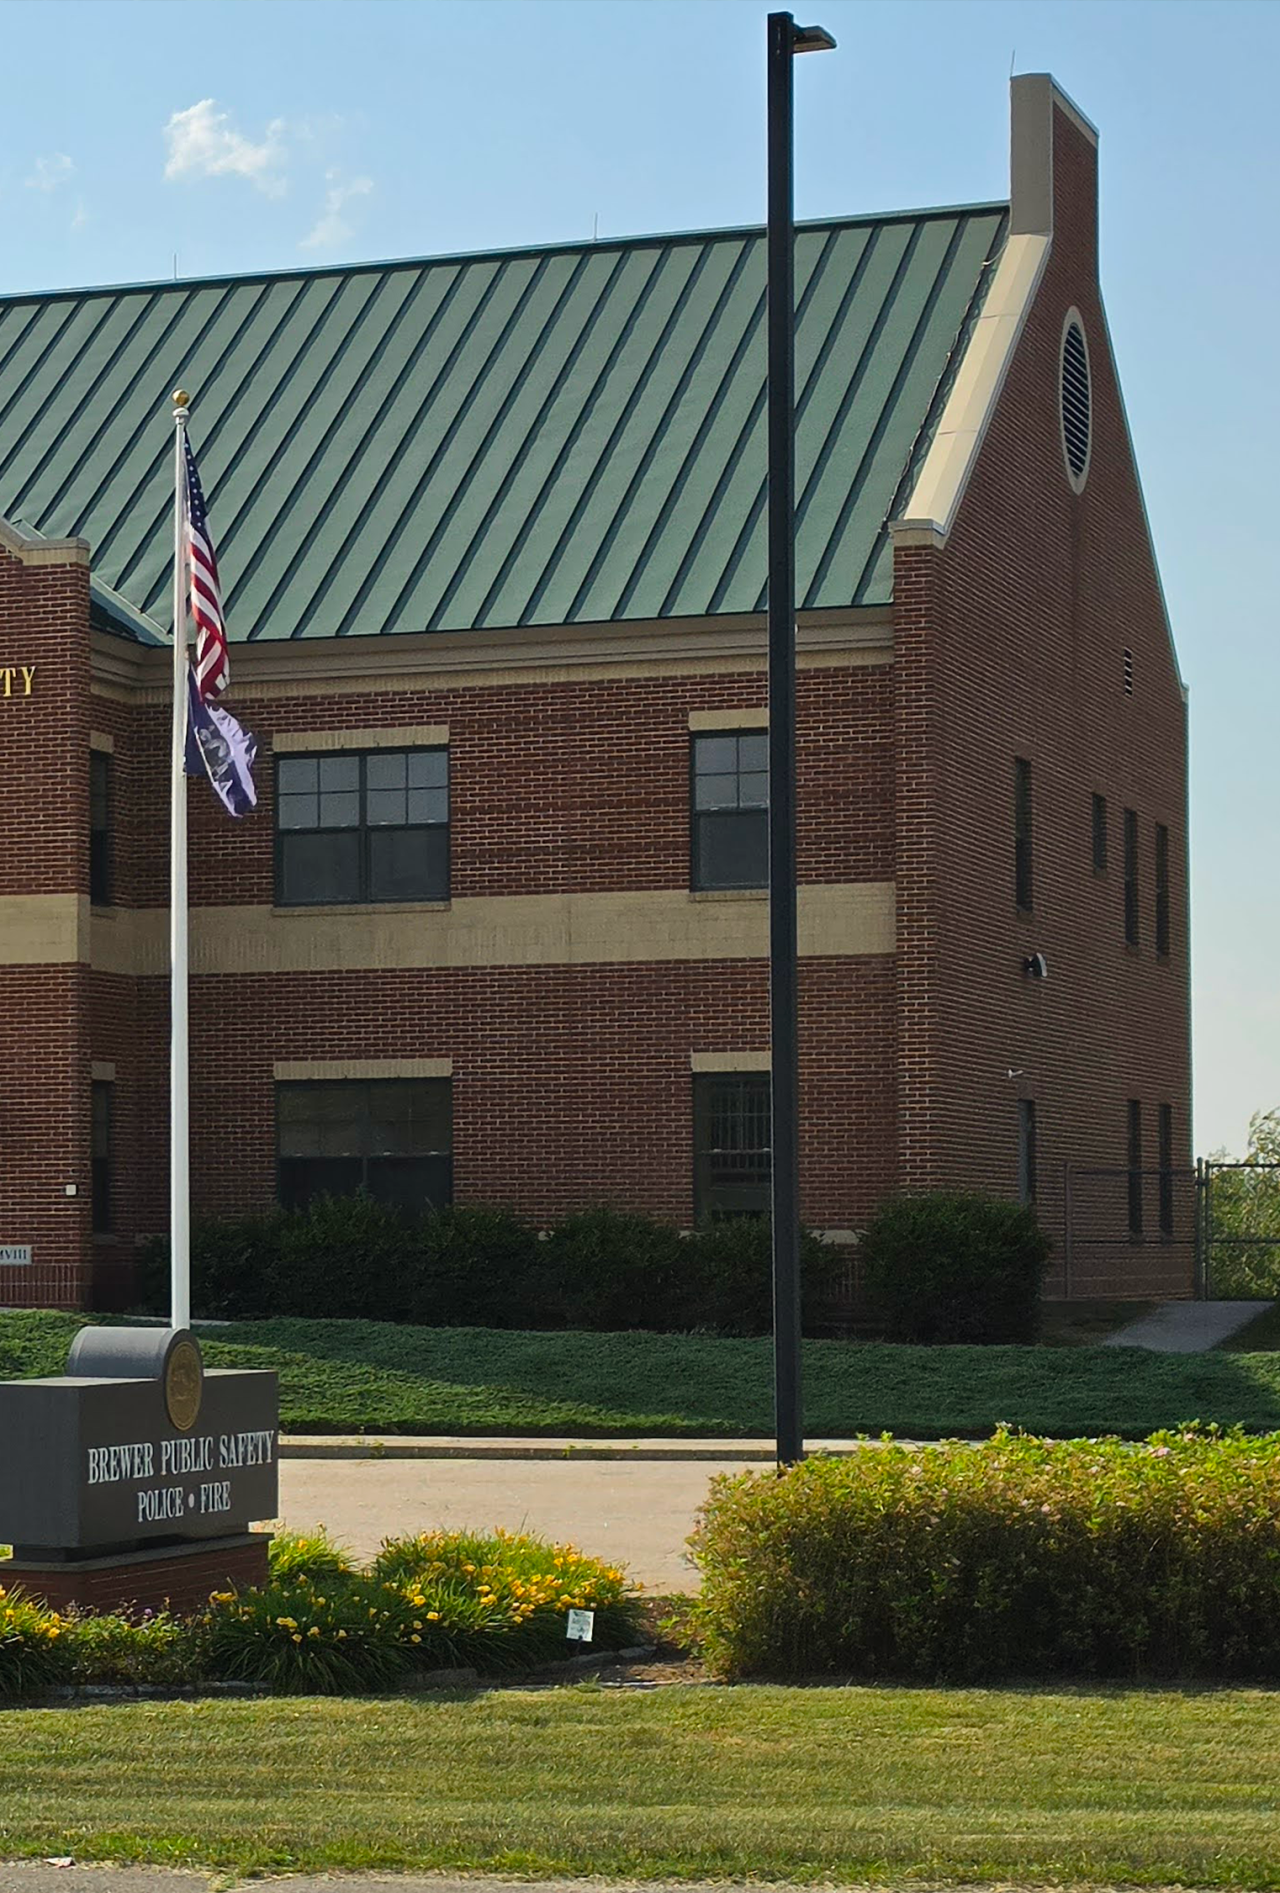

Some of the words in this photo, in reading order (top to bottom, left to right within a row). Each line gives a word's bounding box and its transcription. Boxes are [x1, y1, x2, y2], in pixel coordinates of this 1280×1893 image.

[87, 1442, 154, 1484] BREWER
[160, 1436, 214, 1476] PUBLIC
[219, 1430, 275, 1468] SAFETY
[137, 1487, 184, 1523] POLICE
[200, 1481, 231, 1513] FIRE
